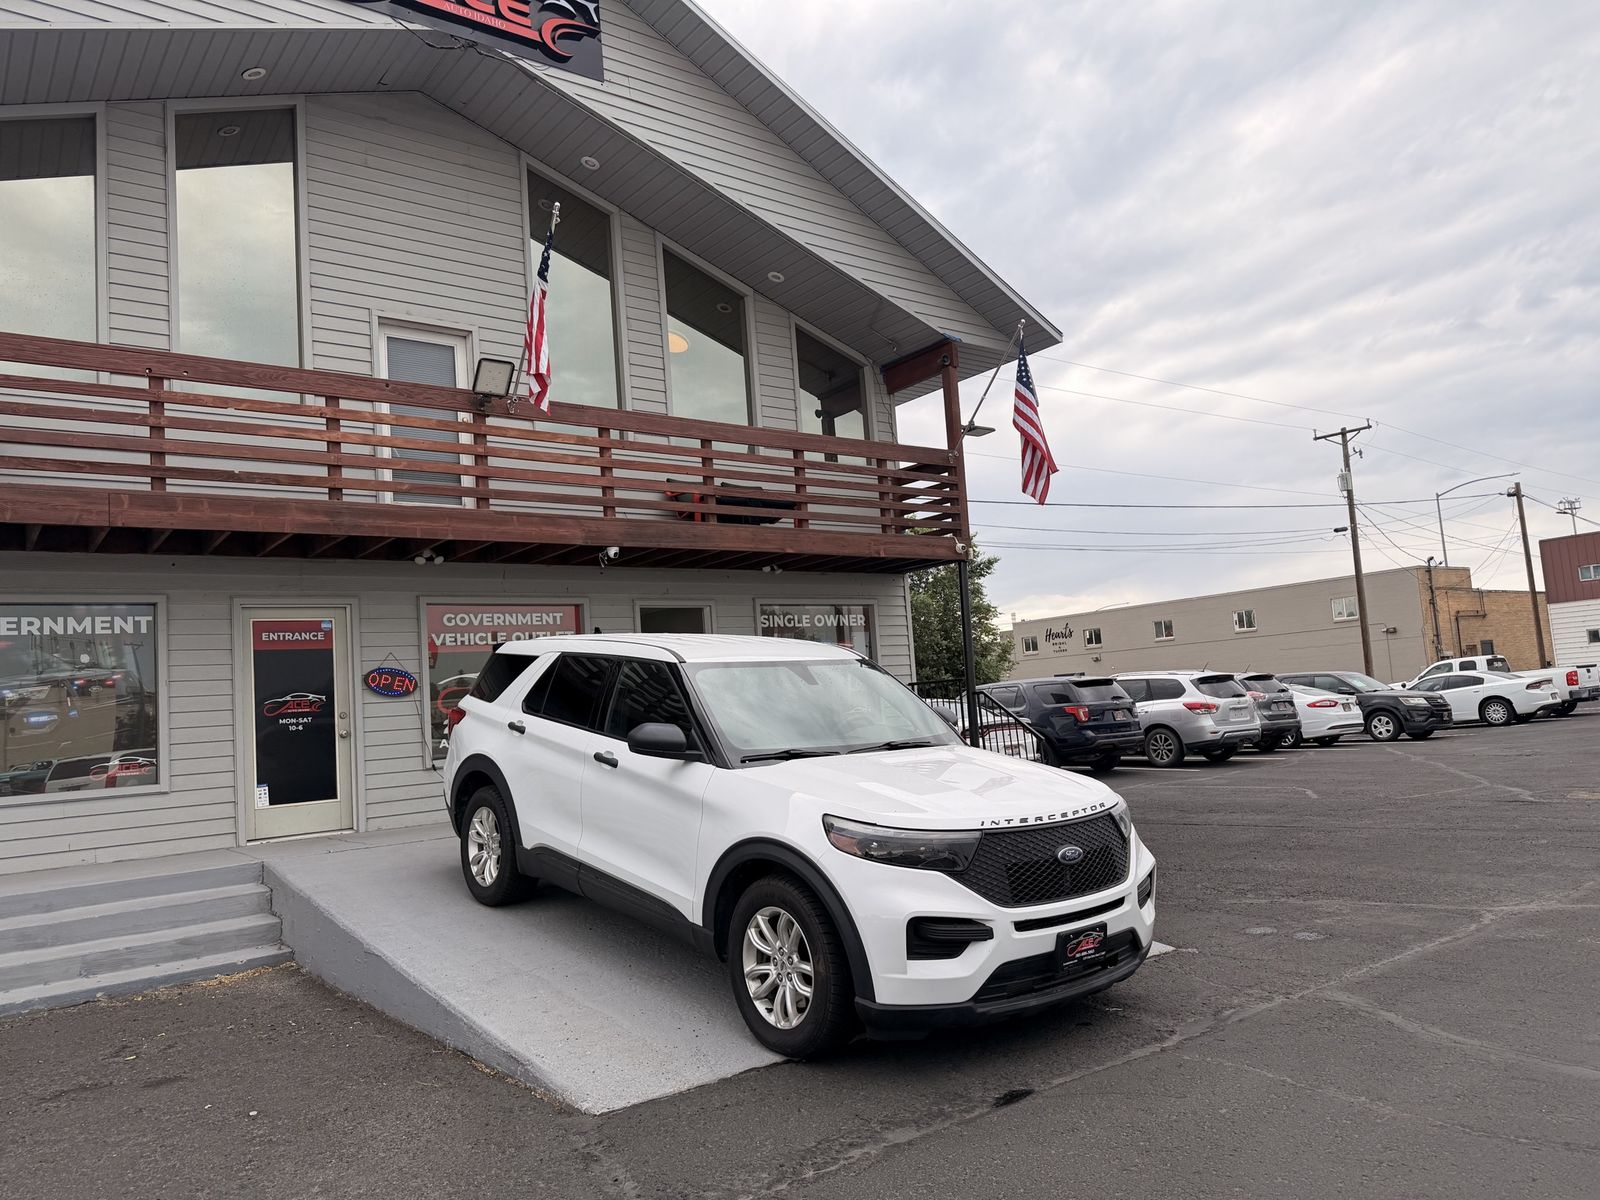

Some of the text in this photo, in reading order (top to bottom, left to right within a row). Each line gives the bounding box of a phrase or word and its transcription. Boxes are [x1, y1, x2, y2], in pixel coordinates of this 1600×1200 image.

[442, 3, 506, 29] AUTO IDAHO
[0, 616, 153, 636] ERNMENT
[443, 612, 563, 626] GOVERNMENT
[760, 614, 866, 628] SINGLE OWNER
[262, 632, 325, 641] ENTRANCE
[431, 631, 507, 646] VEHICLE
[1045, 622, 1074, 643] Hearts
[368, 673, 416, 692] OPEN
[980, 802, 1106, 826] INTERCEPTOR
